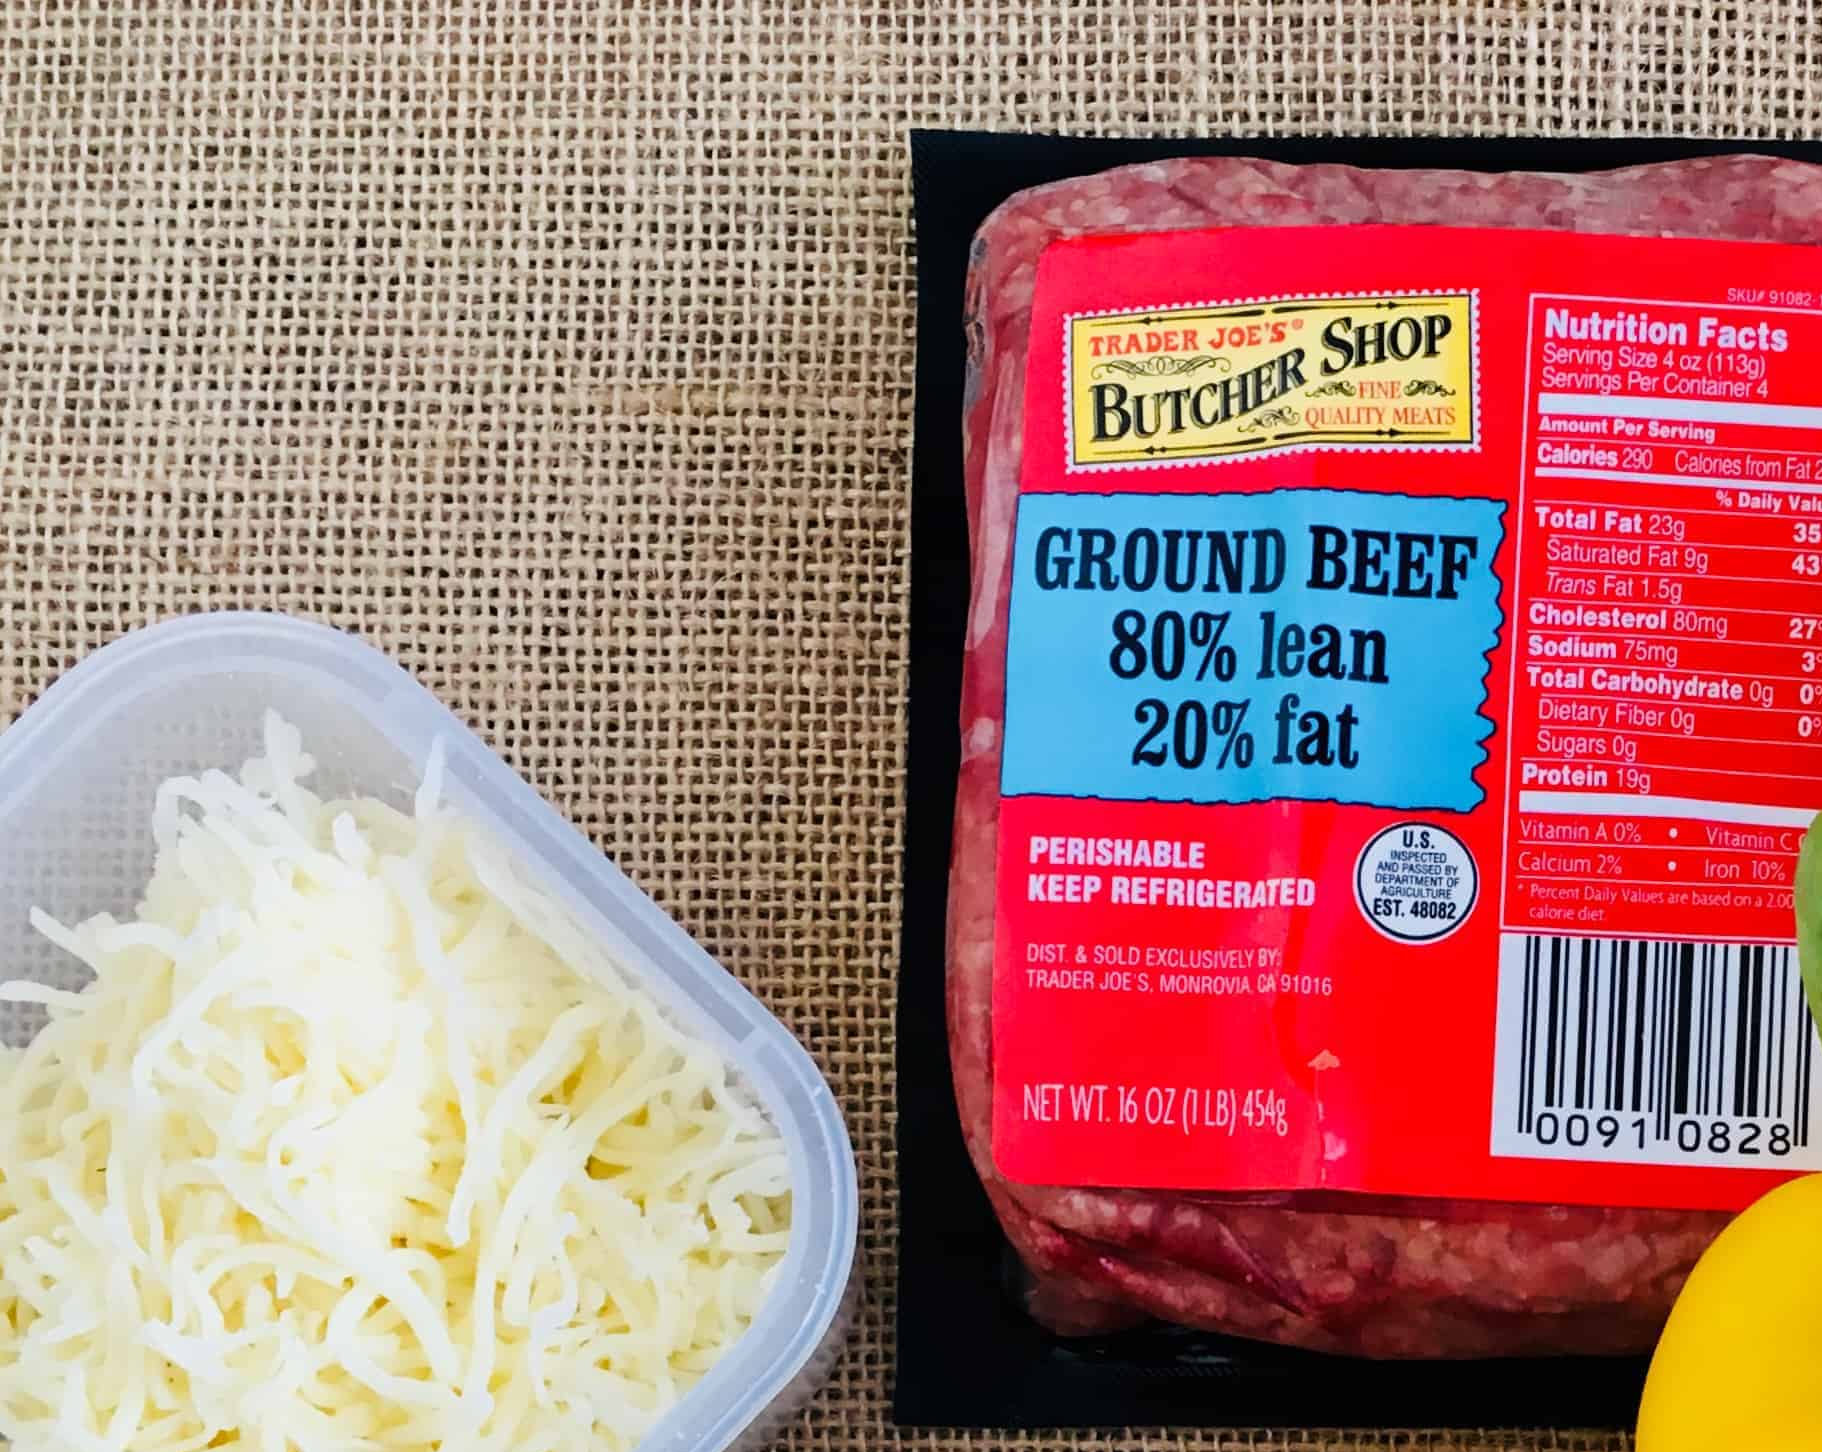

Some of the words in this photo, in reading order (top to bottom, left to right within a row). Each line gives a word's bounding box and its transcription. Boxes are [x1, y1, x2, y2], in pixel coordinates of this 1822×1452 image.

[1089, 329, 1199, 356] TRADER
[1544, 308, 1688, 347] Nutrition
[1697, 317, 1788, 352] Facts
[1542, 343, 1613, 370] Serving
[1618, 346, 1657, 369] Size
[1663, 350, 1674, 368] 4
[1679, 355, 1702, 371] oz
[1707, 353, 1766, 380] (113g)
[1089, 347, 1307, 443] BUTCHER
[1320, 314, 1451, 376] SHOP
[1357, 380, 1400, 399] FINE
[1541, 367, 1622, 395] Servings
[1627, 370, 1658, 393] Per
[1663, 373, 1752, 398] Container
[1756, 381, 1769, 398] 4
[1305, 407, 1388, 429] QUALITY
[1392, 407, 1456, 425] MEATS
[1538, 416, 1608, 436] Amount
[1613, 418, 1643, 436] Per
[1647, 420, 1716, 444] Serving
[1536, 442, 1619, 467] Calories
[1622, 448, 1654, 470] 290
[1674, 451, 1743, 477] Calories
[1745, 453, 1782, 480] from
[1786, 457, 1811, 481] Fat
[1716, 488, 1733, 506] %
[1738, 490, 1782, 514] Daily
[1535, 506, 1596, 531] Total
[1604, 510, 1643, 534] Fat
[1648, 514, 1686, 542] 23g
[1035, 526, 1287, 594] GROUND
[1306, 524, 1477, 601] BEEF
[1546, 539, 1641, 566] Saturated
[1648, 545, 1678, 567] Fat
[1683, 546, 1709, 574] 9g
[1547, 571, 1597, 595] Trans
[1602, 574, 1634, 598] Fat
[1640, 578, 1683, 604] 1.5g
[1529, 602, 1667, 629] Cholesterol
[1672, 610, 1729, 638] 80mg
[1109, 609, 1237, 682] 80%
[1256, 611, 1389, 683] lean
[1527, 634, 1617, 659] Sodium
[1623, 639, 1679, 667] 75mg
[1526, 666, 1585, 689] Total
[1591, 668, 1744, 699] Carbohydrate
[1749, 680, 1774, 707] 0g
[1132, 699, 1254, 770] 20%
[1273, 693, 1359, 769] fat
[1538, 700, 1609, 727] Dietary
[1615, 703, 1665, 726] Fiber
[1670, 710, 1696, 734] 0g
[1536, 730, 1607, 758] Sugars
[1612, 735, 1637, 762] 0g
[1522, 763, 1608, 787] Protein
[1615, 768, 1651, 794] 19g
[1403, 829, 1435, 849] U.S.
[1520, 819, 1589, 839] Vitamin
[1595, 823, 1607, 840] A
[1613, 822, 1641, 843] 0%
[1705, 826, 1774, 850] Vitamin
[1779, 832, 1792, 850] C
[1029, 836, 1205, 869] PERISHABLE
[1390, 850, 1447, 864] INSPECTED
[1518, 851, 1592, 873] Calcium
[1596, 854, 1622, 875] 2%
[1704, 860, 1740, 880] Iron
[1751, 860, 1785, 881] 10%
[1375, 873, 1443, 887] DEPARTMENT
[1446, 876, 1460, 888] OF
[1377, 861, 1399, 873] AND
[1402, 863, 1441, 875] PASSED
[1444, 865, 1458, 876] BY
[1028, 874, 1101, 903] KEEP
[1111, 876, 1315, 908] REFRIGERATED
[1381, 886, 1452, 900] AGRICULTURE
[1530, 883, 1580, 900] Percent
[1583, 886, 1617, 904] Daily
[1621, 889, 1664, 904] Values
[1667, 893, 1688, 905] are
[1691, 891, 1731, 906] based
[1733, 895, 1751, 907] on
[1754, 897, 1762, 907] a
[1373, 897, 1405, 917] EST.
[1410, 900, 1457, 920] 48082
[1529, 905, 1575, 920] calorie
[1027, 944, 1068, 963] DIST.
[1075, 945, 1087, 963] &
[1094, 945, 1140, 966] SOLD
[1146, 948, 1254, 969] EXCLUSIVELY
[1026, 969, 1095, 989] TRADER
[1257, 974, 1276, 993] CA
[1281, 974, 1332, 996] 91016
[1023, 1083, 1064, 1121] NET
[1069, 1084, 1111, 1122] WT.
[1117, 1086, 1138, 1124] 16
[1145, 1087, 1176, 1125] OZ
[1182, 1087, 1197, 1136] (1
[1205, 1088, 1237, 1136] LB)
[1241, 1088, 1288, 1137] 454g
[1535, 1111, 1646, 1151] 0091
[1677, 1119, 1792, 1157] 0828
